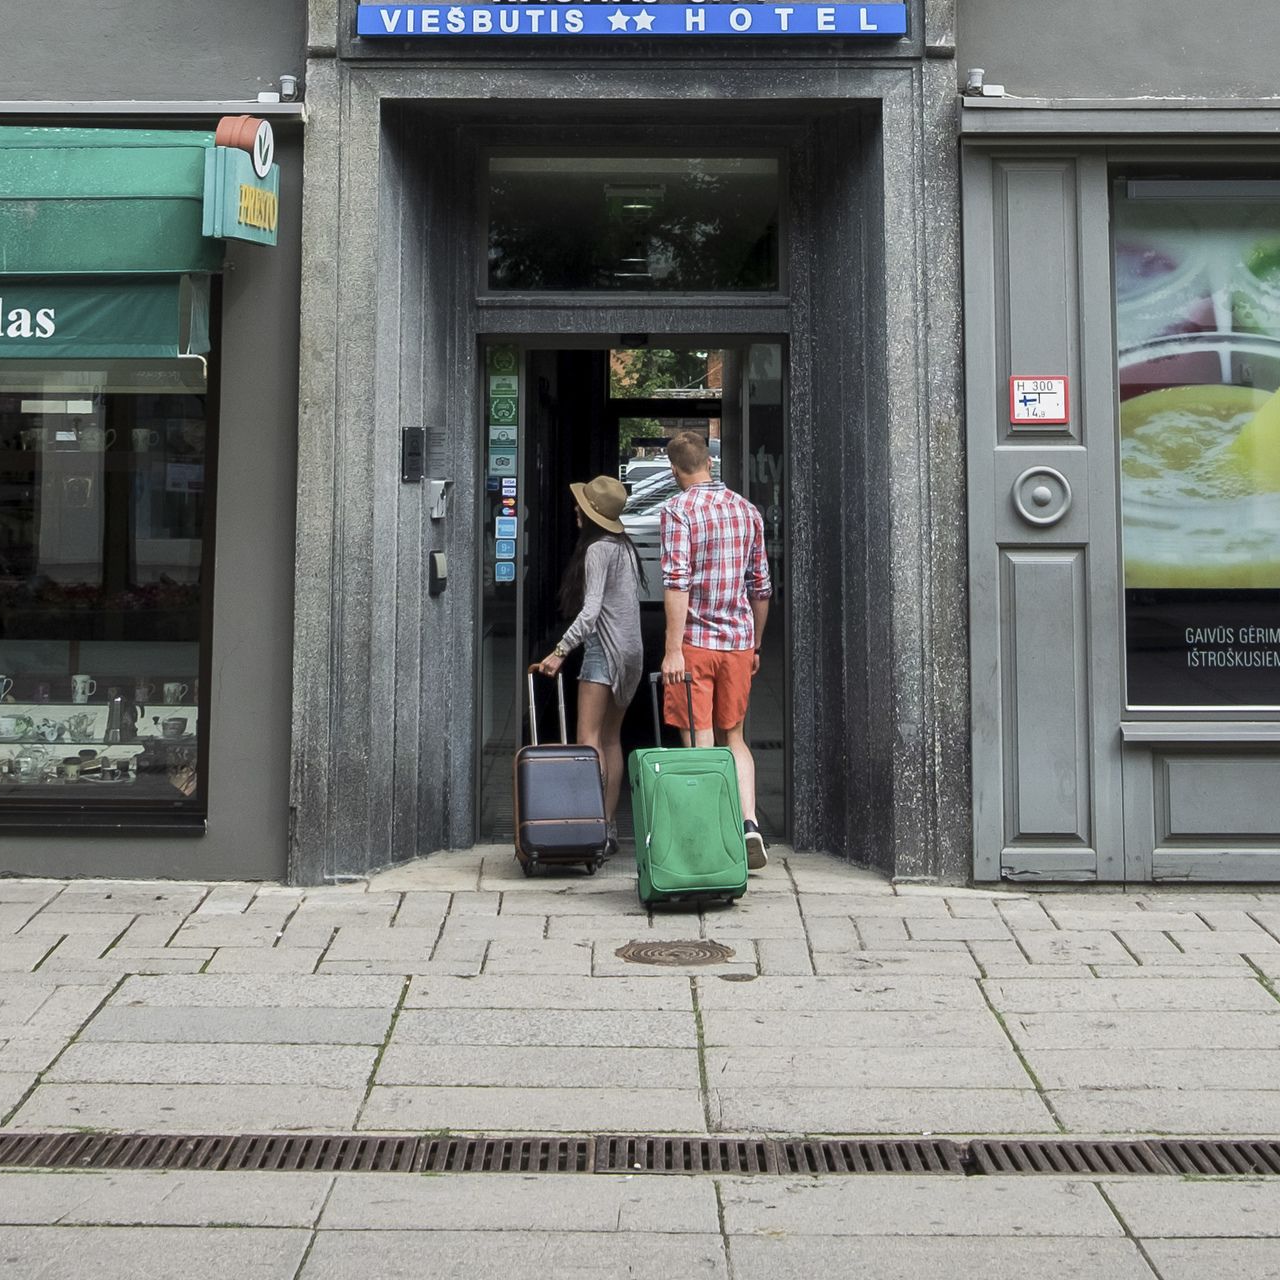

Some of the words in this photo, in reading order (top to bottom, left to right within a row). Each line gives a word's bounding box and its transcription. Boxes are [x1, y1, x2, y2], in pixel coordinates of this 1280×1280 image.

[380, 6, 584, 33] VIEŠBUTIS
[685, 8, 878, 33] HOTEL
[238, 184, 277, 231] PRESTO
[1017, 381, 1025, 391] H
[1032, 381, 1053, 391] 300
[1185, 625, 1234, 644] GAIVŪS
